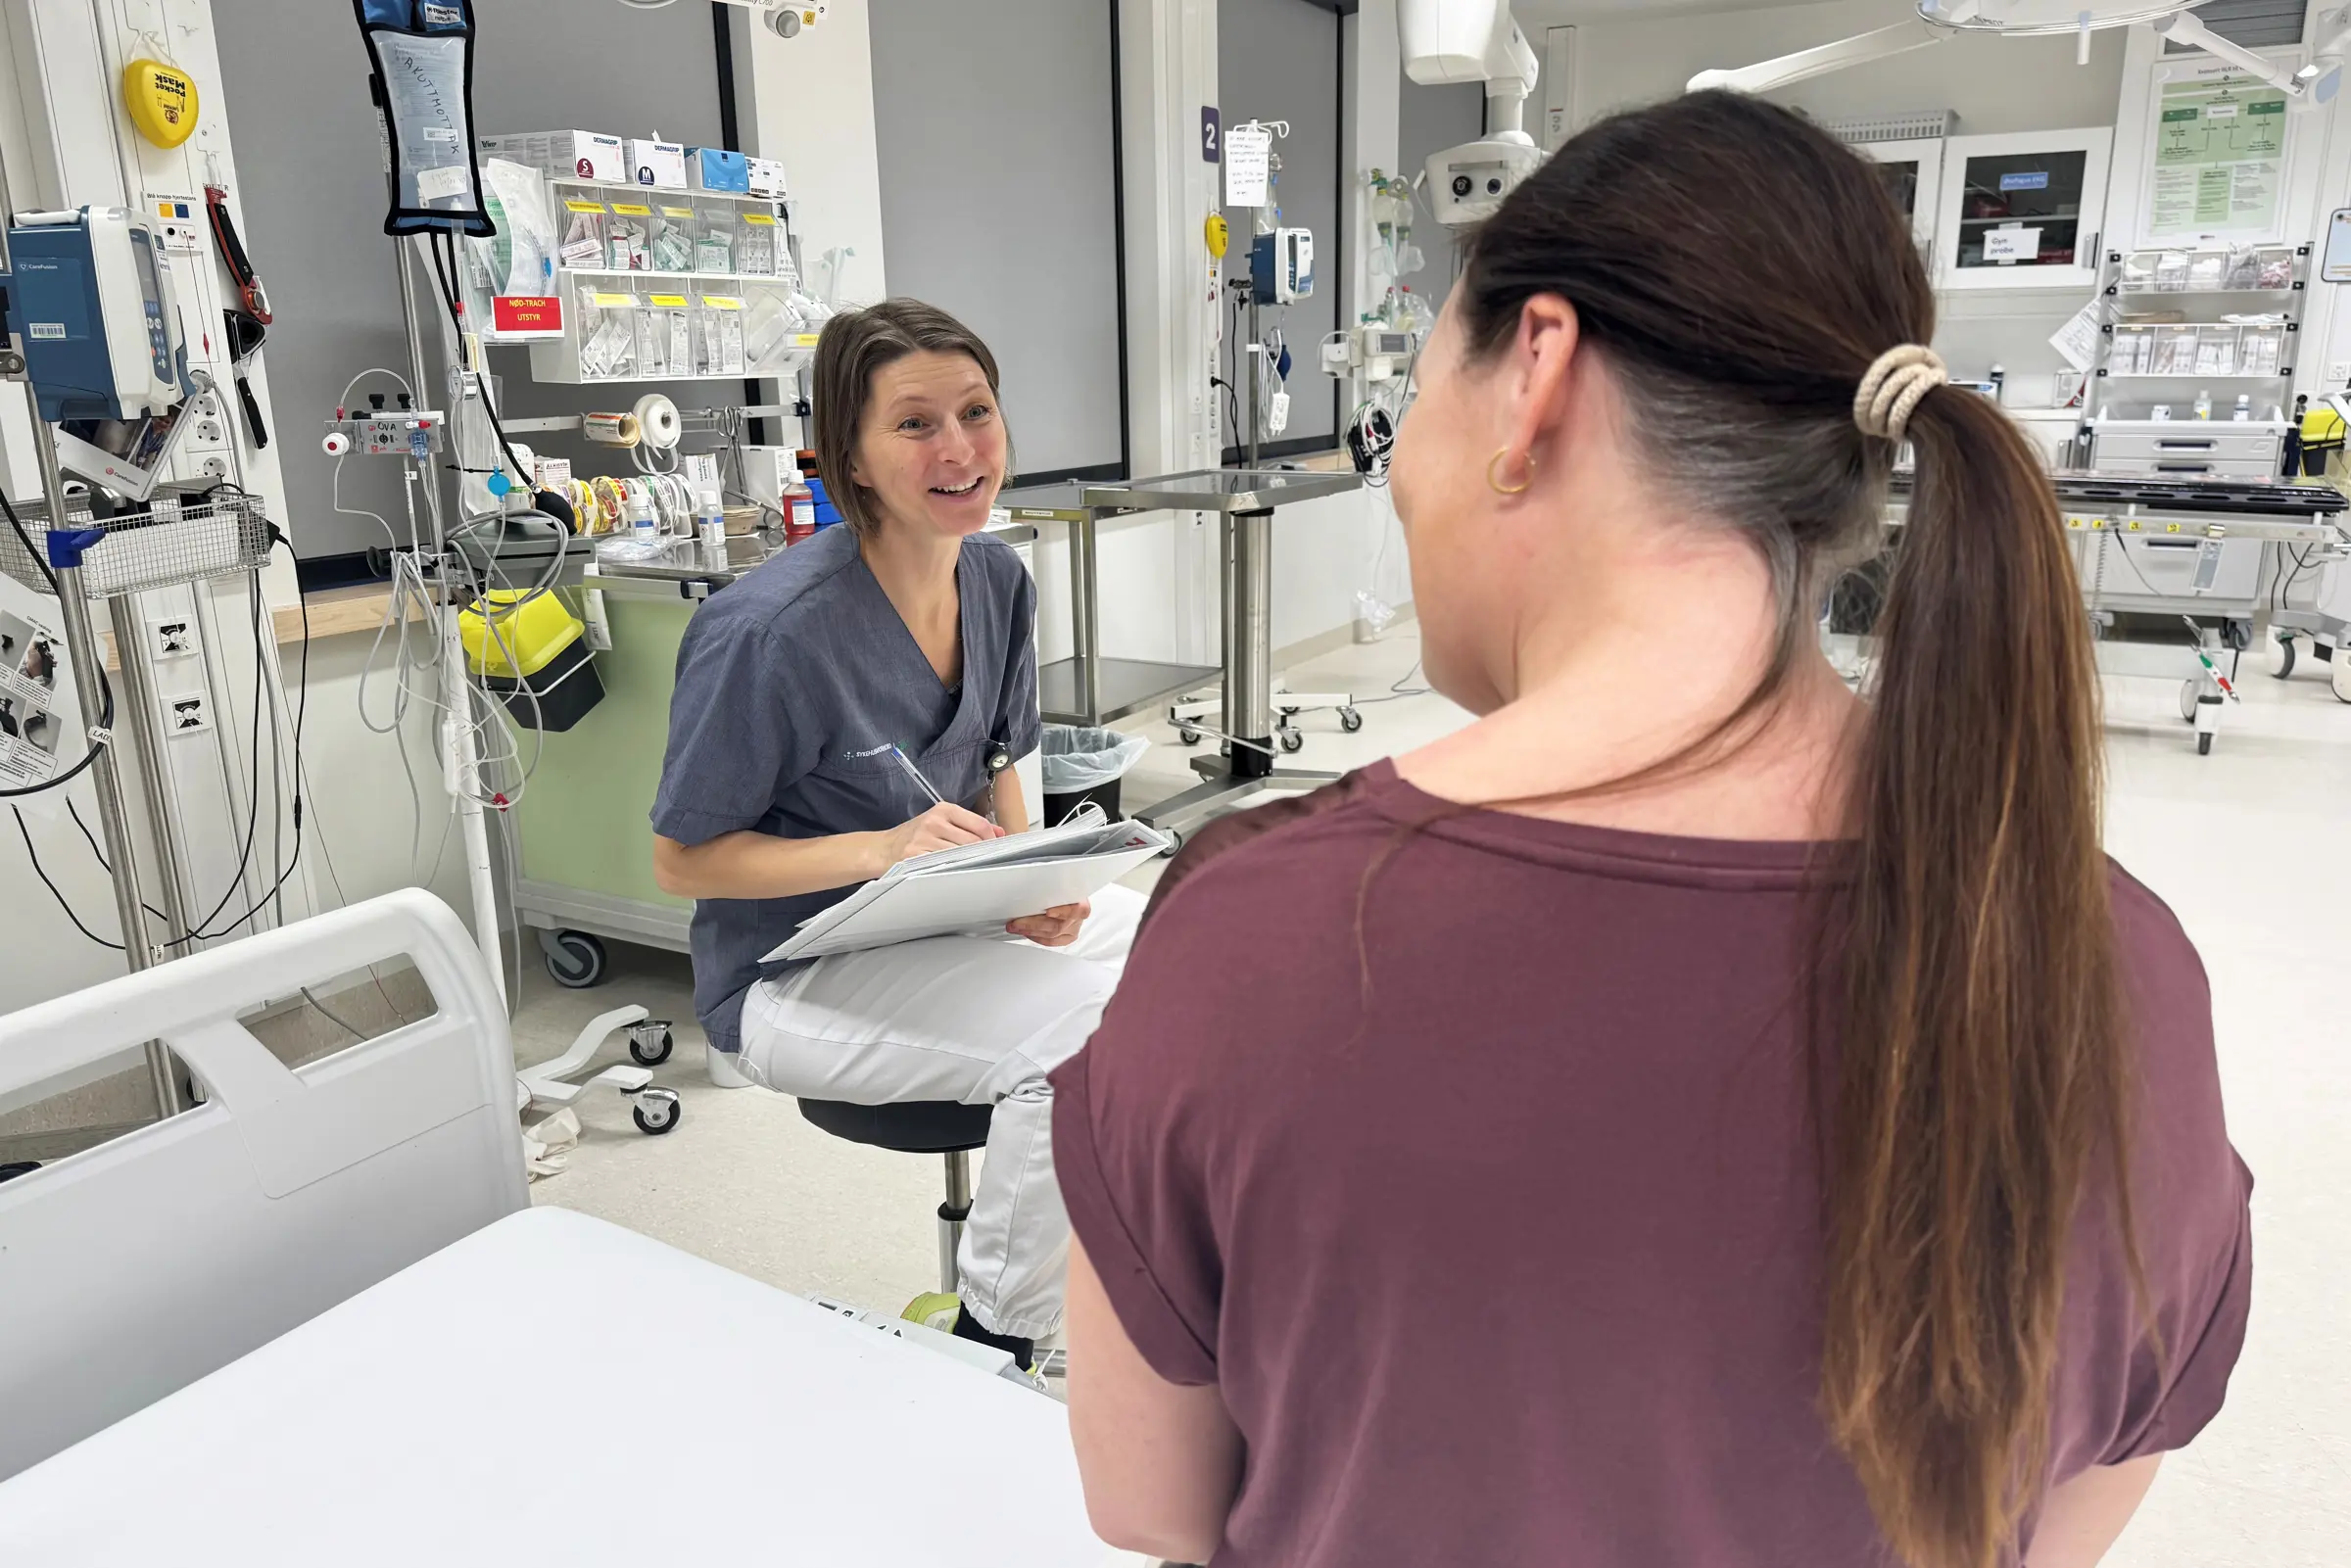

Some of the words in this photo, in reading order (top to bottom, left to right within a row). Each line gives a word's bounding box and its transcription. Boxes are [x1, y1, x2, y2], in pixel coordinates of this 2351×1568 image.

[155, 72, 186, 90] Mask
[155, 82, 186, 98] Pocket
[1206, 122, 1216, 149] 2
[582, 160, 589, 171] S
[642, 167, 651, 180] M
[508, 299, 547, 309] NØD-TRACH
[517, 313, 542, 322] UTSTYR
[114, 471, 139, 487] CareFusion
